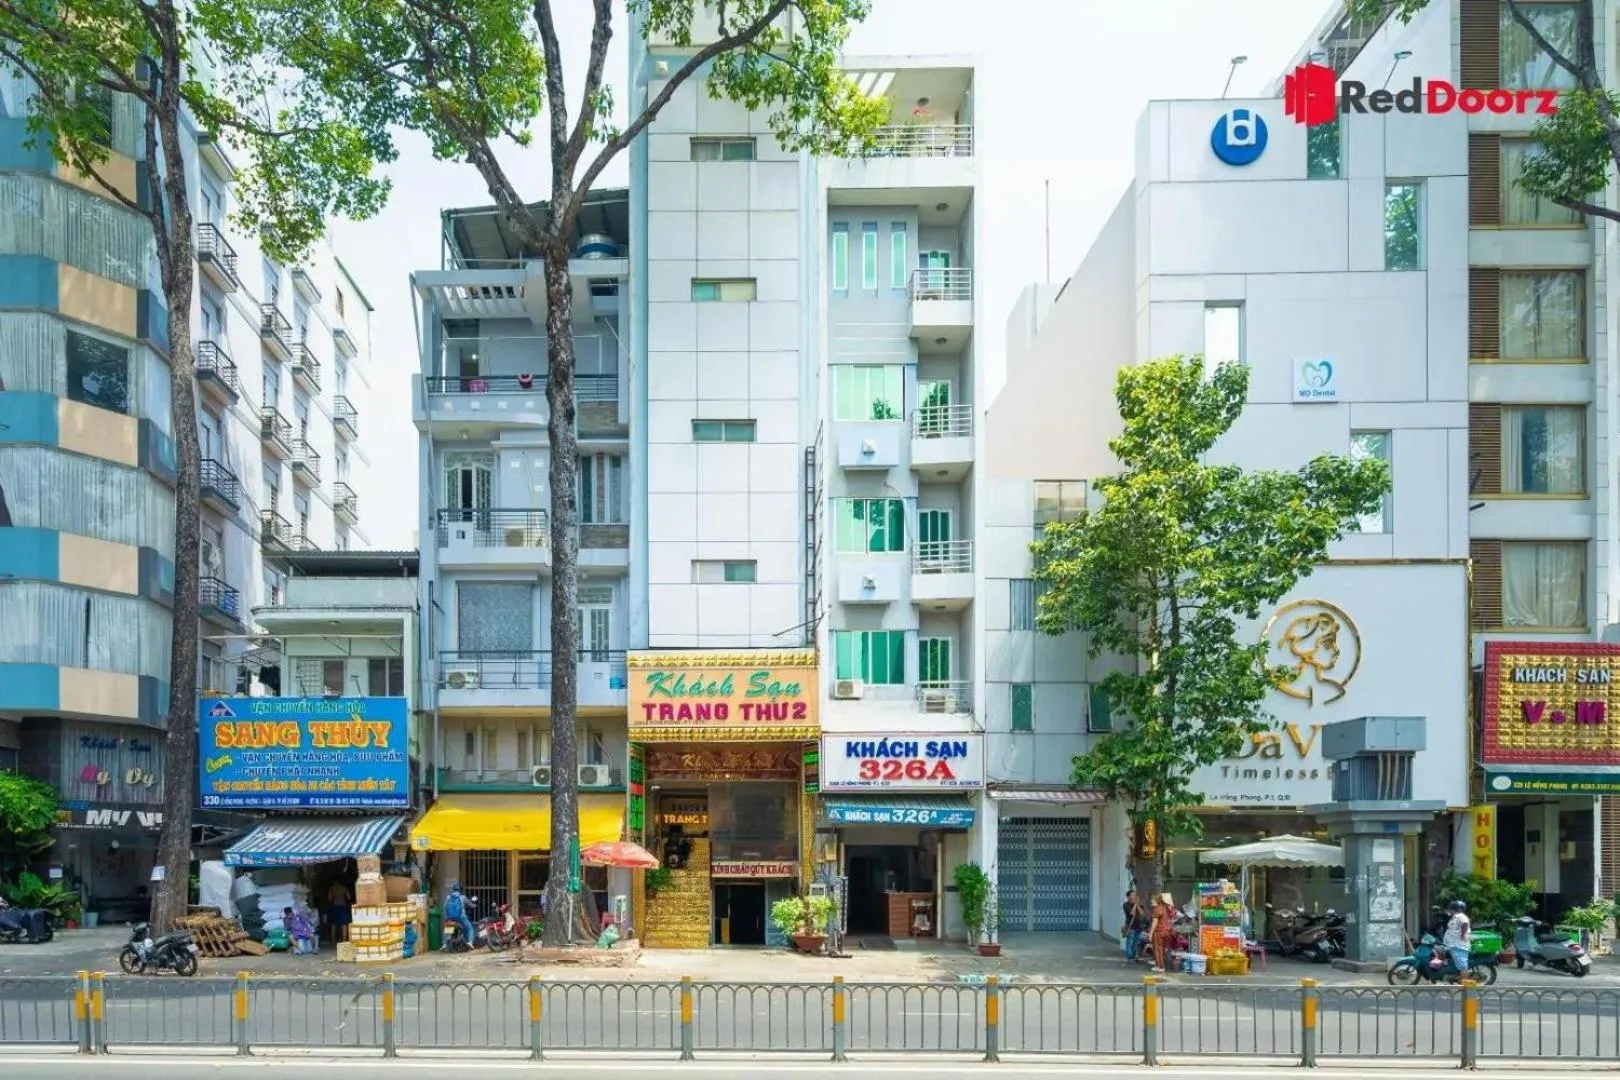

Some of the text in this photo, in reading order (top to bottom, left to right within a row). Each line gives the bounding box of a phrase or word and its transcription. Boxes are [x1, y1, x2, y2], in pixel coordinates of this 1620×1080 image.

[1514, 664, 1567, 682] KHÁCH
[647, 671, 801, 702] Khách Sạn
[642, 702, 729, 721] TRANG
[215, 720, 300, 748] SANG
[846, 738, 968, 761] KHÁCH SẠN
[859, 759, 956, 780] 326A
[1221, 766, 1319, 780] Timeless
[203, 796, 220, 806] 330
[845, 810, 871, 822] KHÁCH
[1475, 812, 1491, 880] HOT
